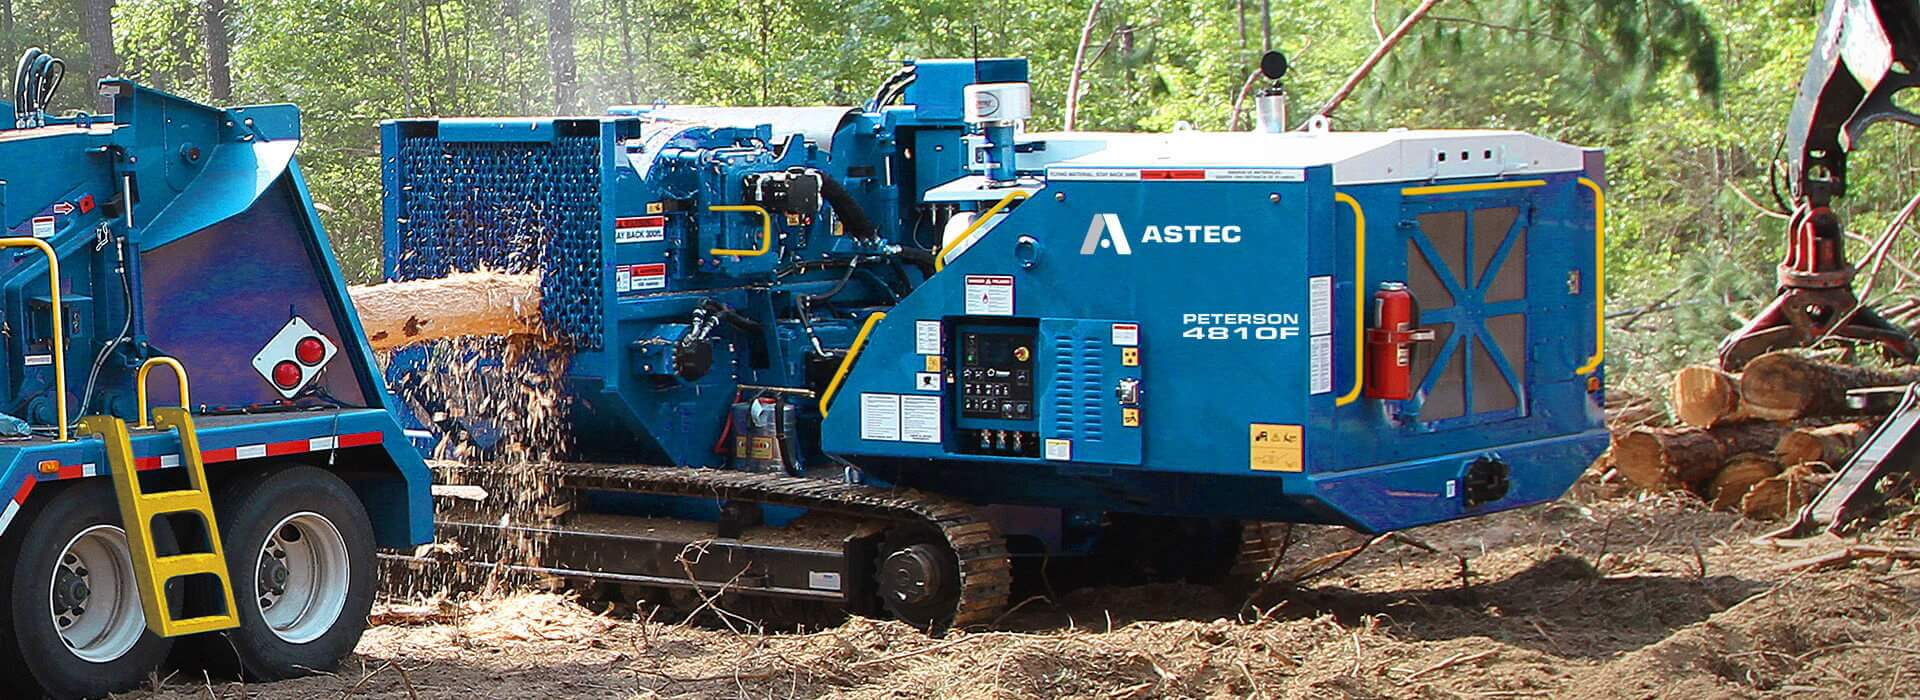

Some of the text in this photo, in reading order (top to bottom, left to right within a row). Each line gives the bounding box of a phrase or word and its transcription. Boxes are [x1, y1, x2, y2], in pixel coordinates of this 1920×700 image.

[626, 230, 644, 239] BACK
[1141, 225, 1242, 243] ASTEC
[1183, 313, 1298, 324] PETERSON
[1183, 327, 1300, 340] 4810F
